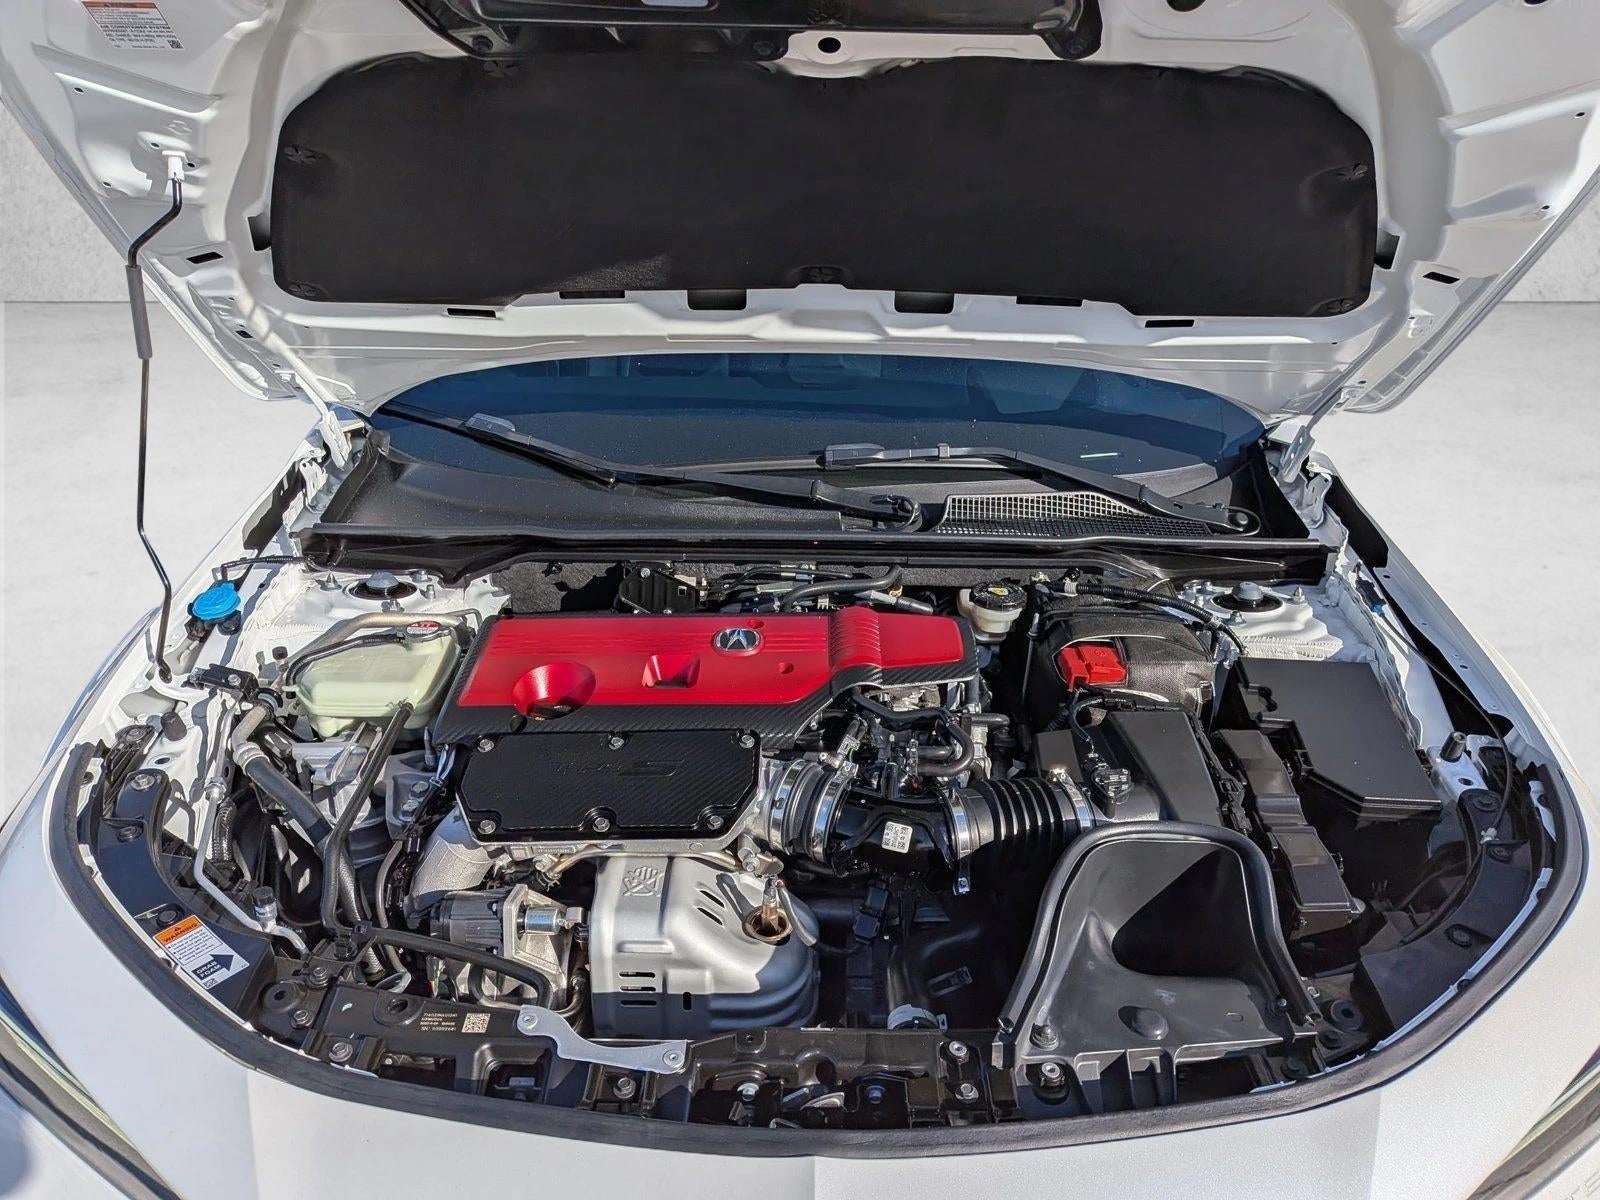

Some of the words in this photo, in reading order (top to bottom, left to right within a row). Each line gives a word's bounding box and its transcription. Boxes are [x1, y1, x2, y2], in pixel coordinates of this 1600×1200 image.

[163, 923, 198, 943] WARNING
[196, 961, 218, 974] GRAB
[200, 964, 222, 978] FOAM
